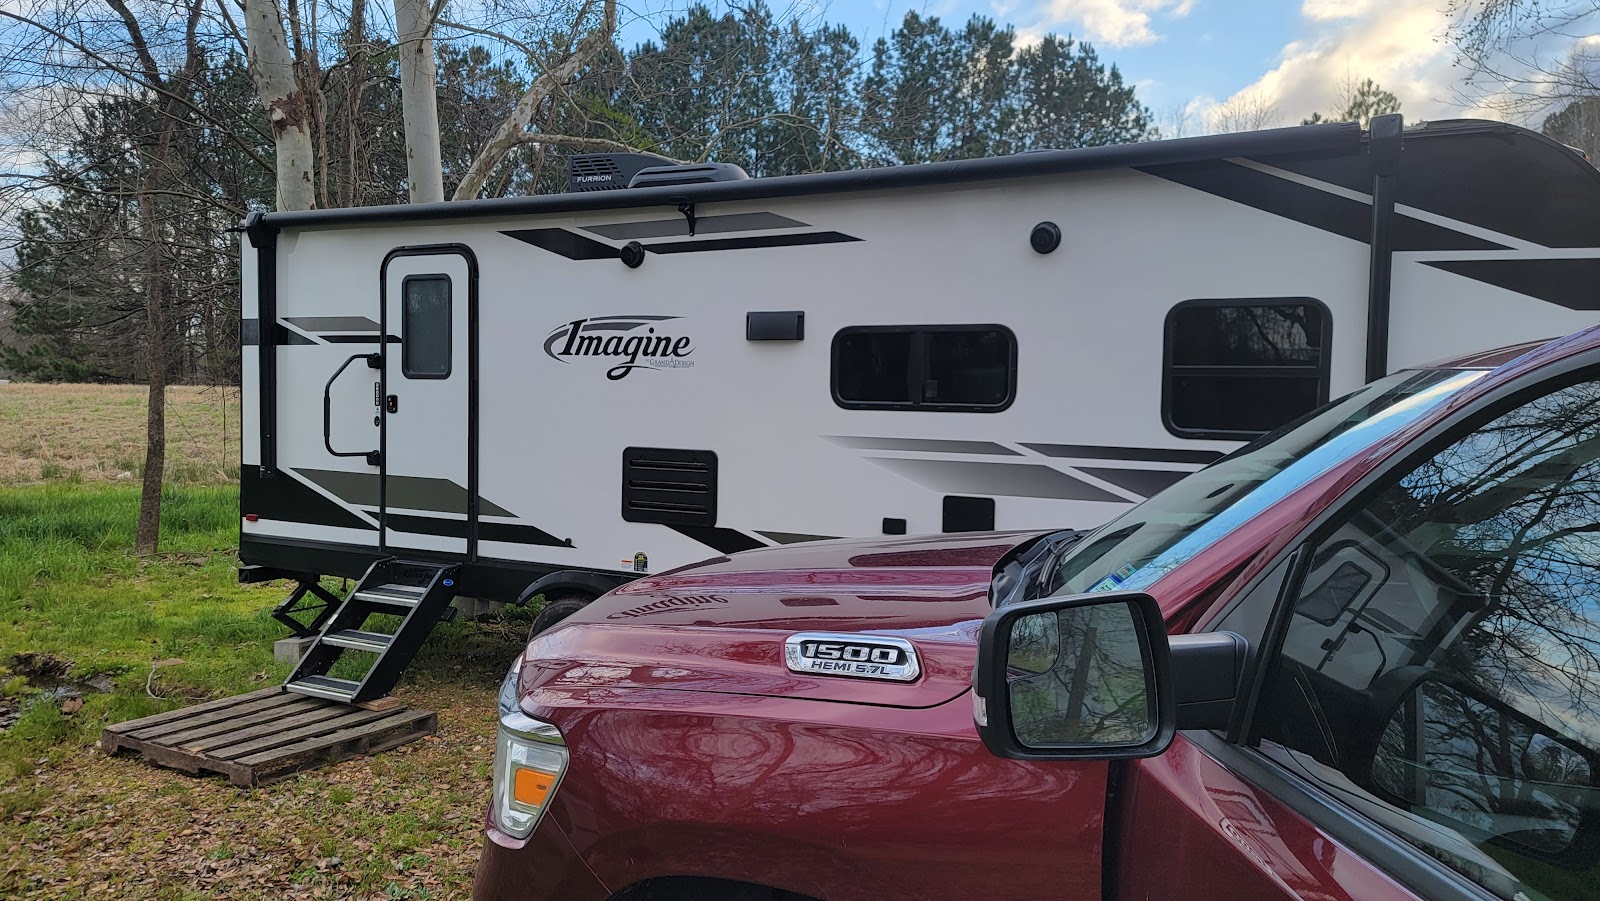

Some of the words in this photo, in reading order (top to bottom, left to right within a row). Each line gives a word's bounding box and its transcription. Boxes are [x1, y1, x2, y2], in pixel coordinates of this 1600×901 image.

[557, 319, 697, 381] Imagine
[805, 643, 898, 664] 1500
[811, 661, 852, 672] HEMI
[854, 664, 891, 675] 5.7L
